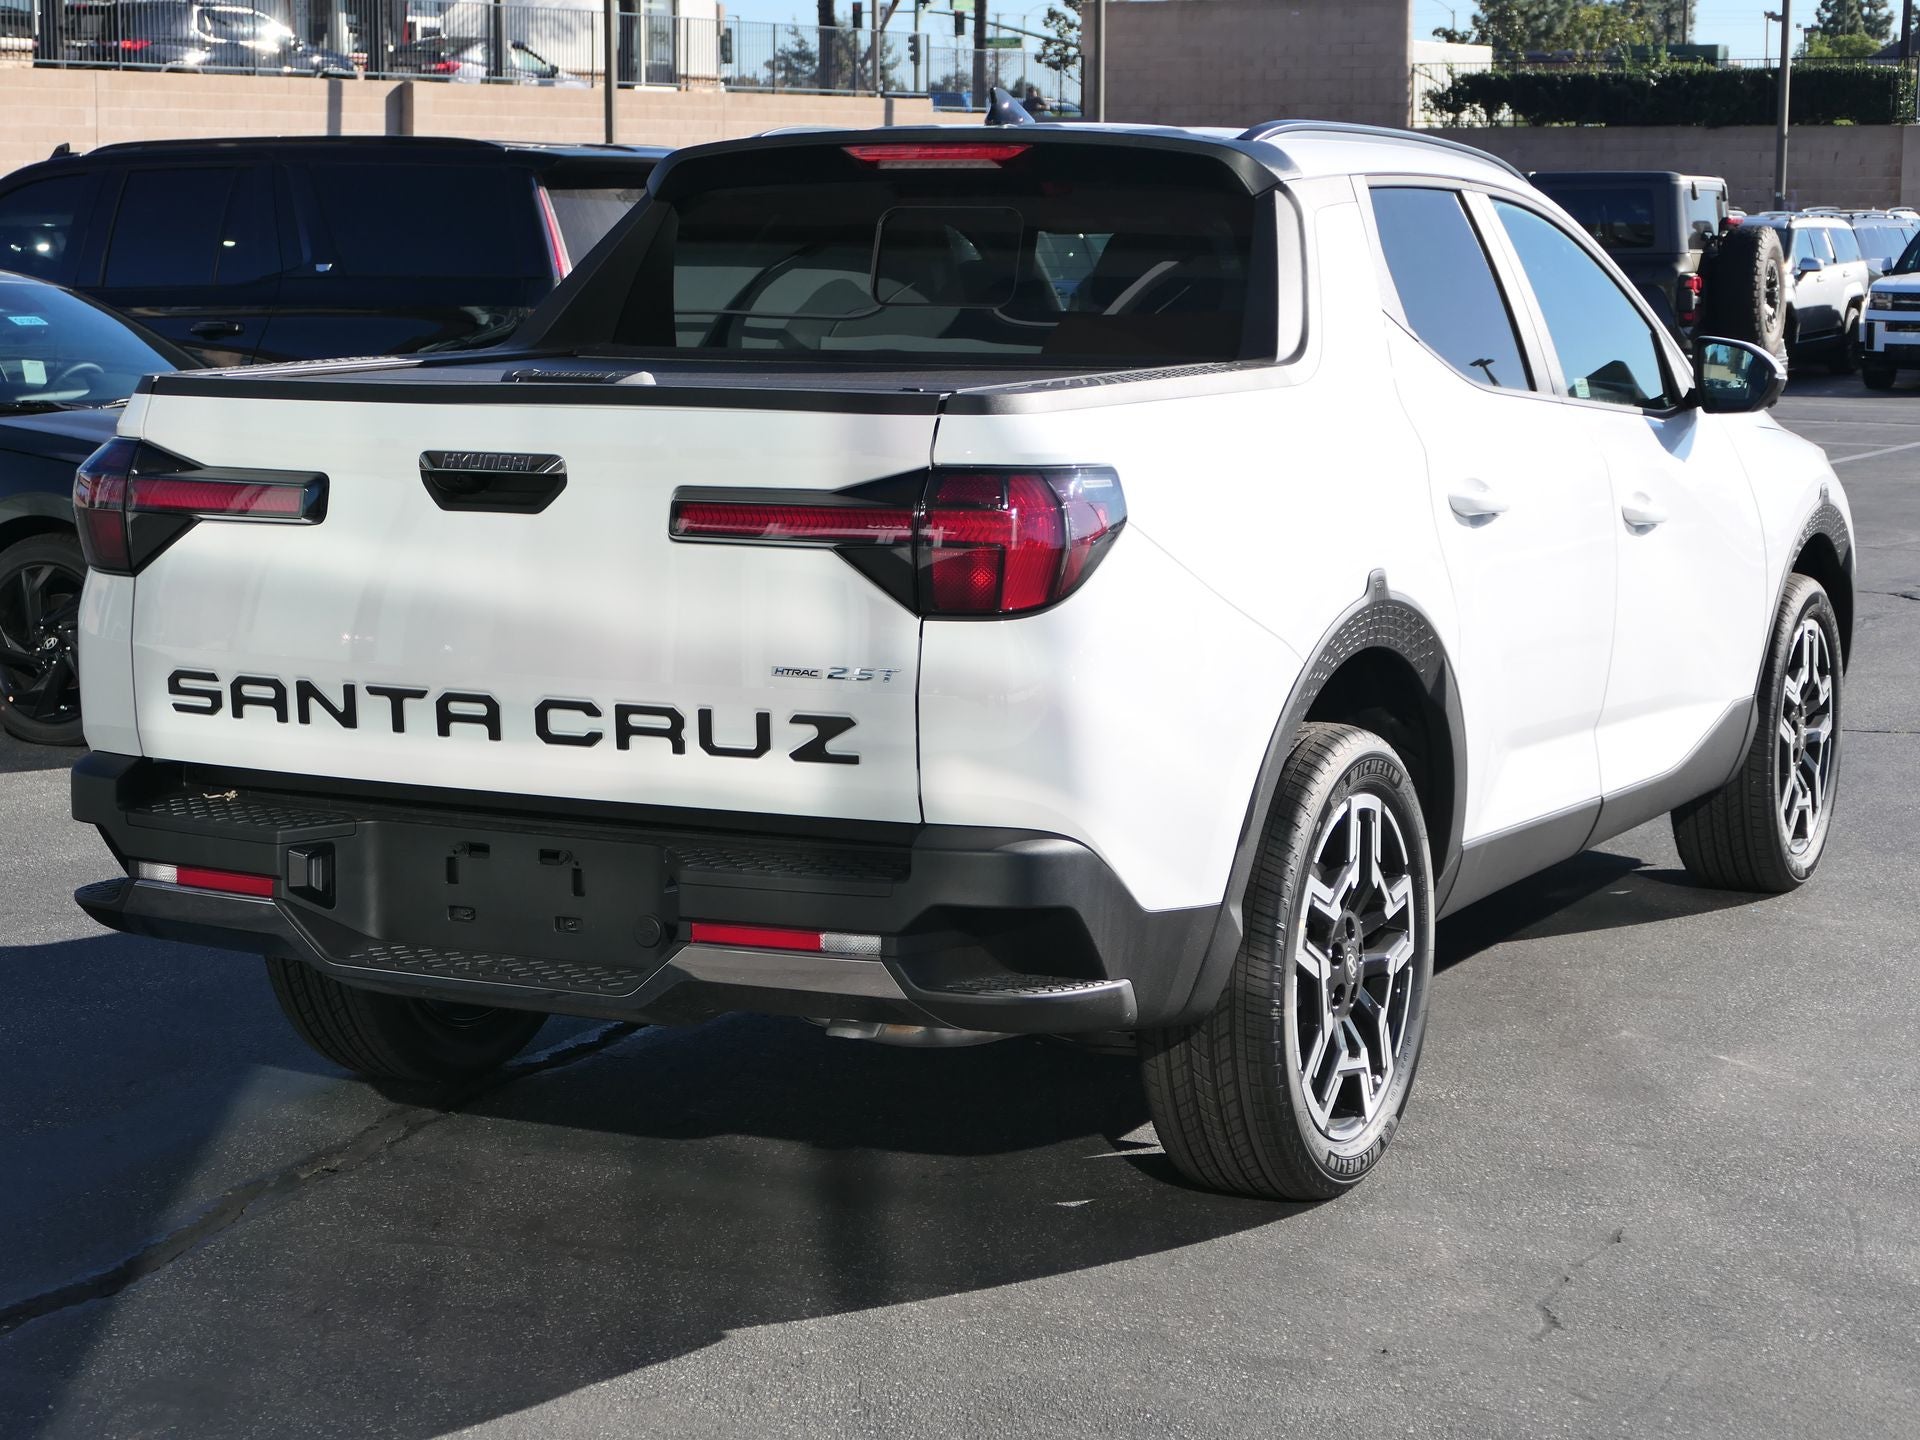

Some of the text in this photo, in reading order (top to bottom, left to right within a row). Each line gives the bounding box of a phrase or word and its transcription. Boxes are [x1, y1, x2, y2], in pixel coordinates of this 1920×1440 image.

[442, 453, 533, 471] HYUNDAI
[775, 668, 819, 677] HTRAC
[167, 668, 861, 766] SANTA CRUZ
[1350, 759, 1401, 785] MICHELIN
[1329, 1140, 1382, 1174] MICHELIN
